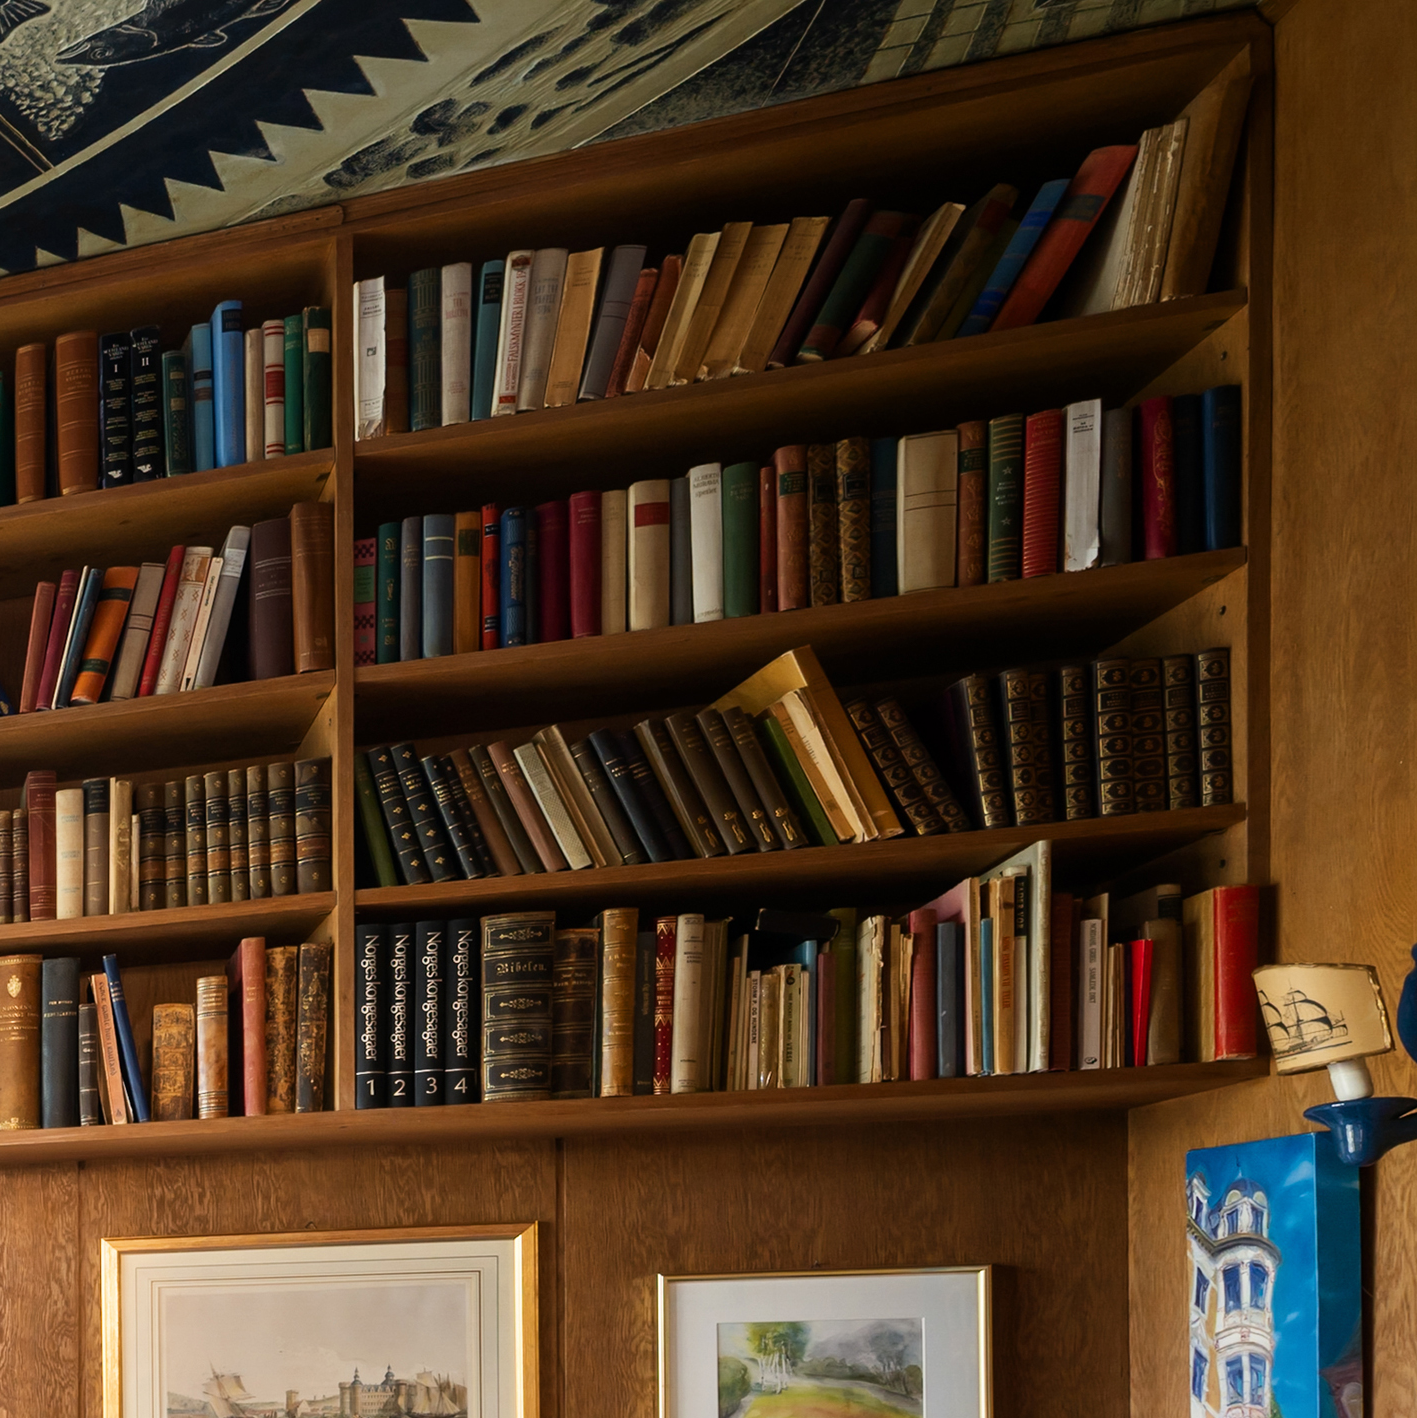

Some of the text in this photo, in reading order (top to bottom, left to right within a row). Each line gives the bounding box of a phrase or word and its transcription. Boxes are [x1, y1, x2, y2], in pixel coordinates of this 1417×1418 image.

[360, 935, 381, 1061] Norges kongesagaer
[390, 934, 411, 1061] Norges kongesagaer
[422, 932, 443, 1059] Norges kongesagaer
[452, 930, 473, 1058] Norges kongesagaer
[752, 1007, 757, 1016] OG
[366, 1079, 375, 1096] 1
[393, 1079, 406, 1097] 2
[425, 1077, 438, 1095] 3
[454, 1078, 468, 1094] 4
